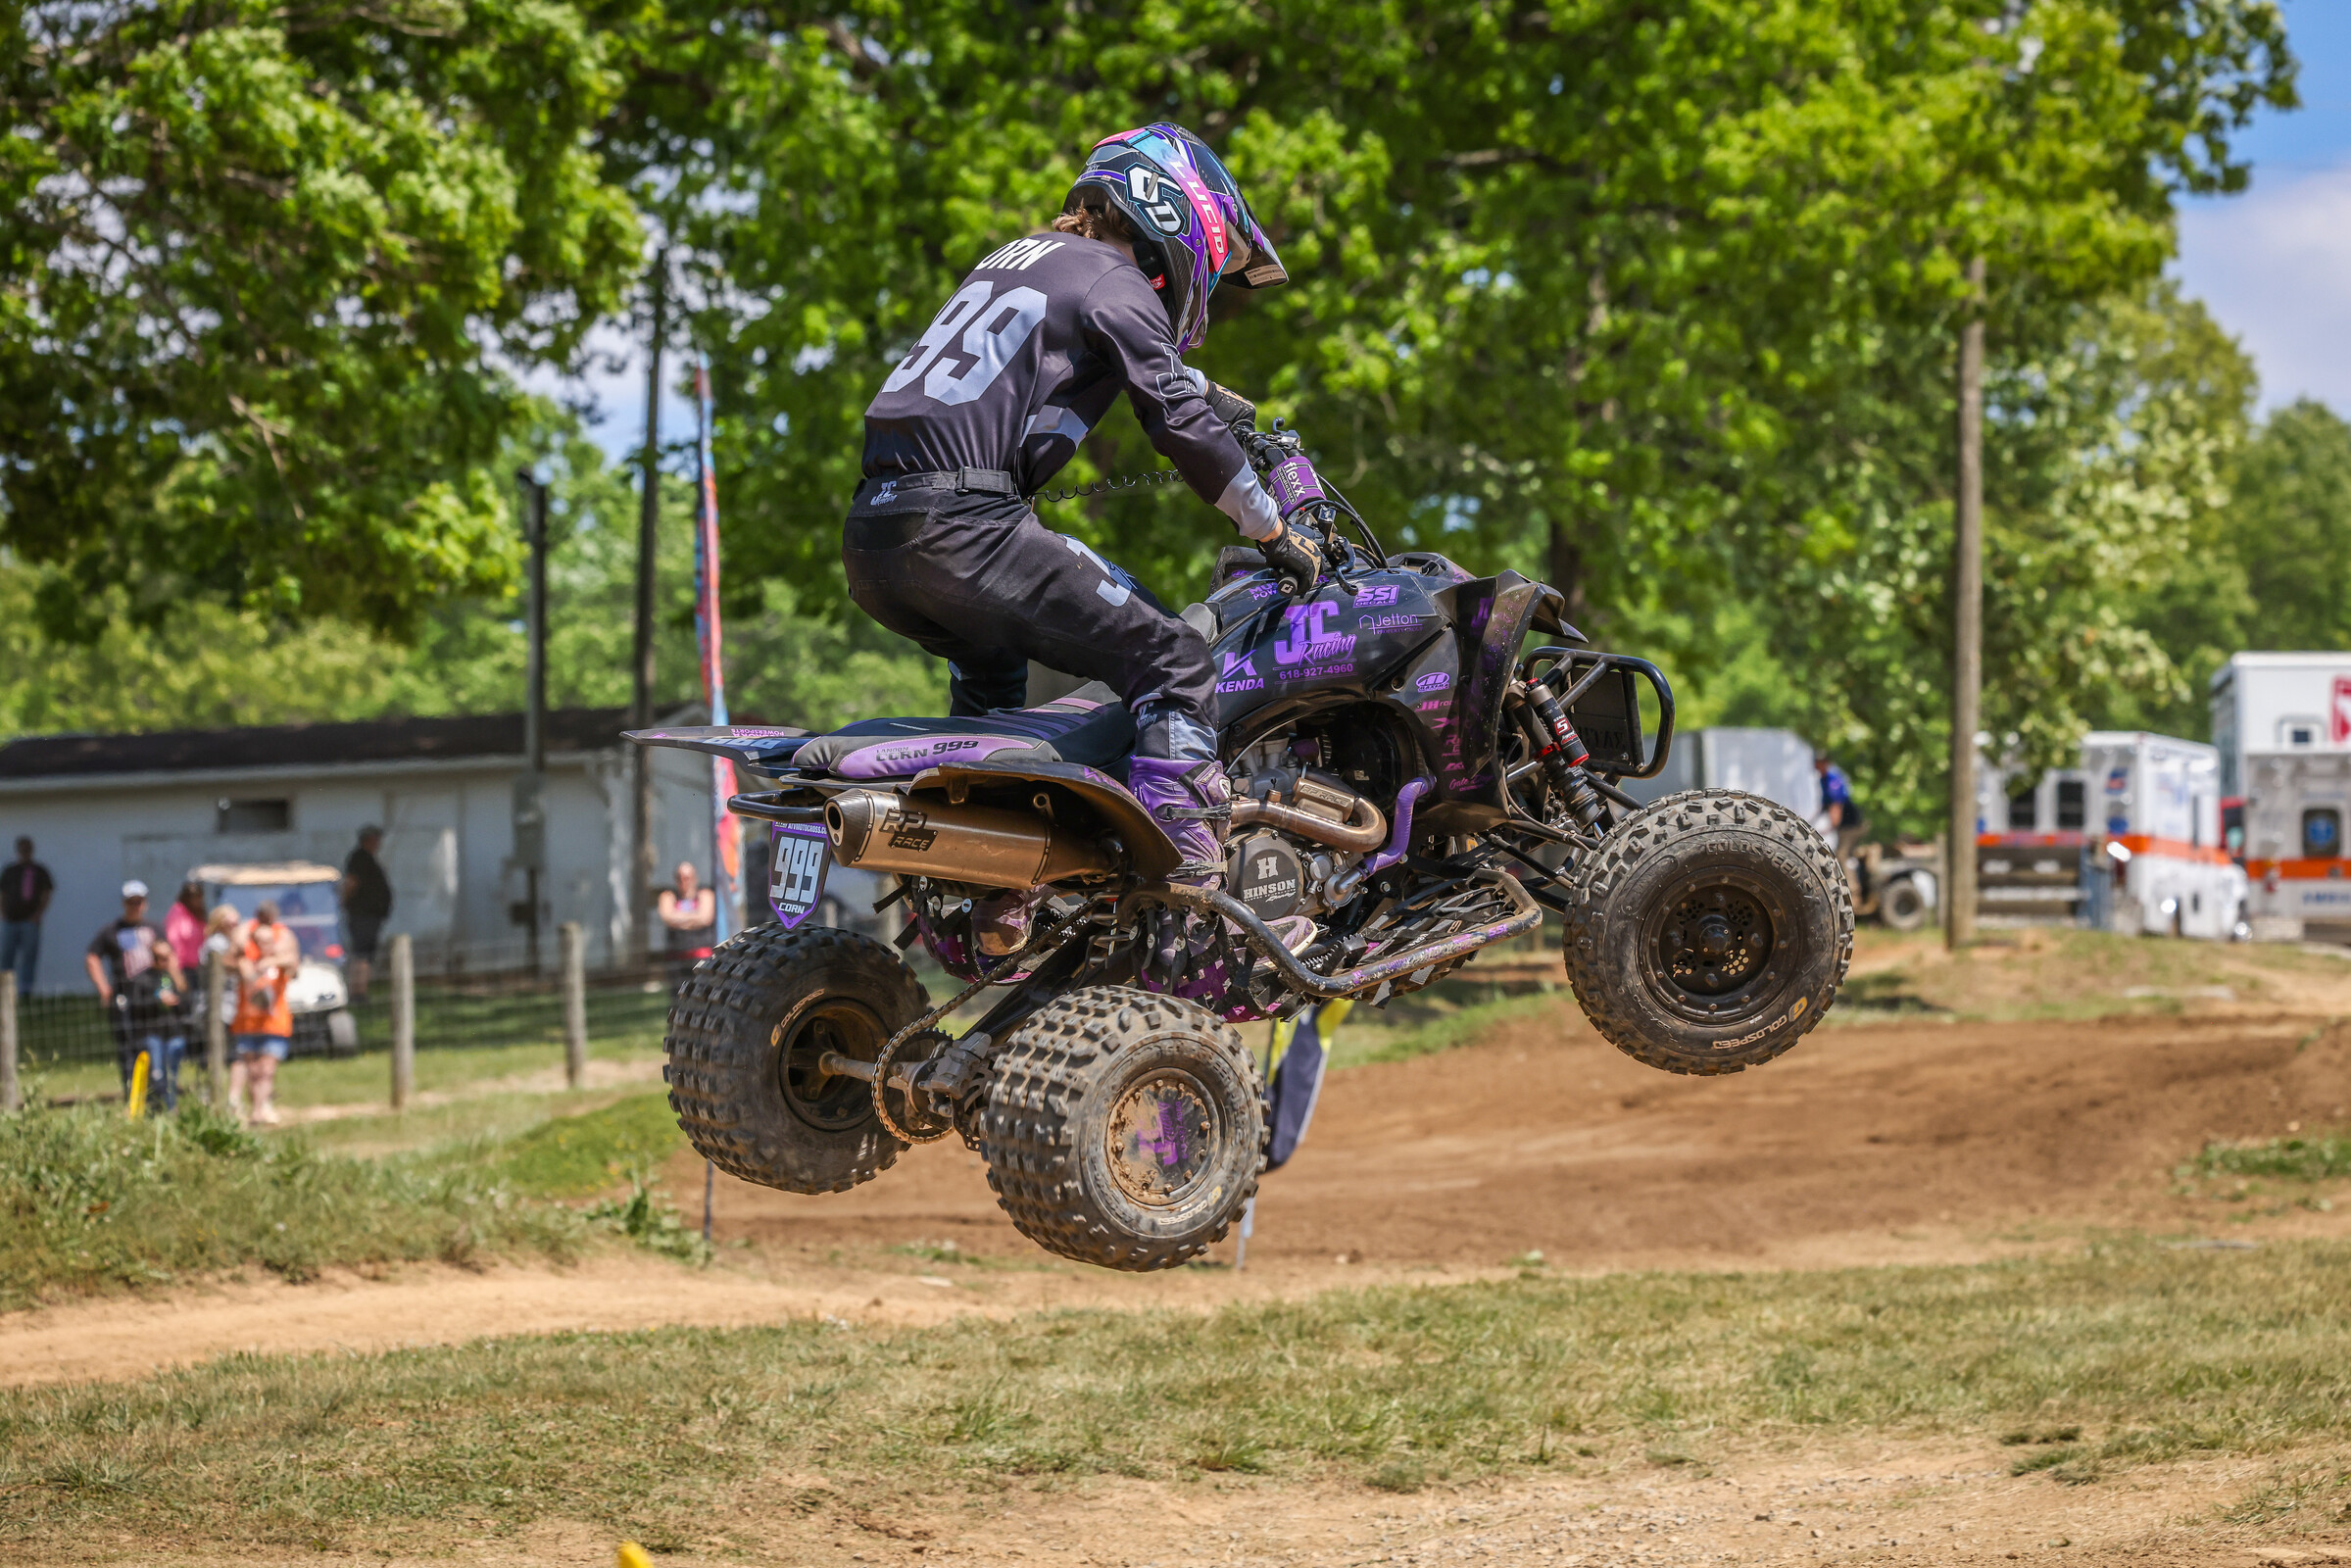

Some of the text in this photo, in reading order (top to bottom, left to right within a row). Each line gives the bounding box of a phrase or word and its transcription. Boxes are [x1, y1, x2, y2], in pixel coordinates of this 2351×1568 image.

[1169, 161, 1224, 254] LUCID
[1283, 462, 1306, 498] flexx
[1357, 586, 1397, 603] SSI
[1376, 612, 1418, 627] Jetton
[1275, 601, 1340, 665] JC
[1298, 633, 1358, 666] Racing
[1279, 663, 1353, 680] 618-927-4960
[1214, 677, 1264, 694] KENDA
[876, 741, 979, 761] CORN 999
[893, 836, 930, 849] RACE
[769, 836, 825, 904] 999
[1243, 878, 1296, 900] HINSON
[778, 902, 806, 914] CORN
[1712, 1014, 1788, 1050] GOLDSPEED
